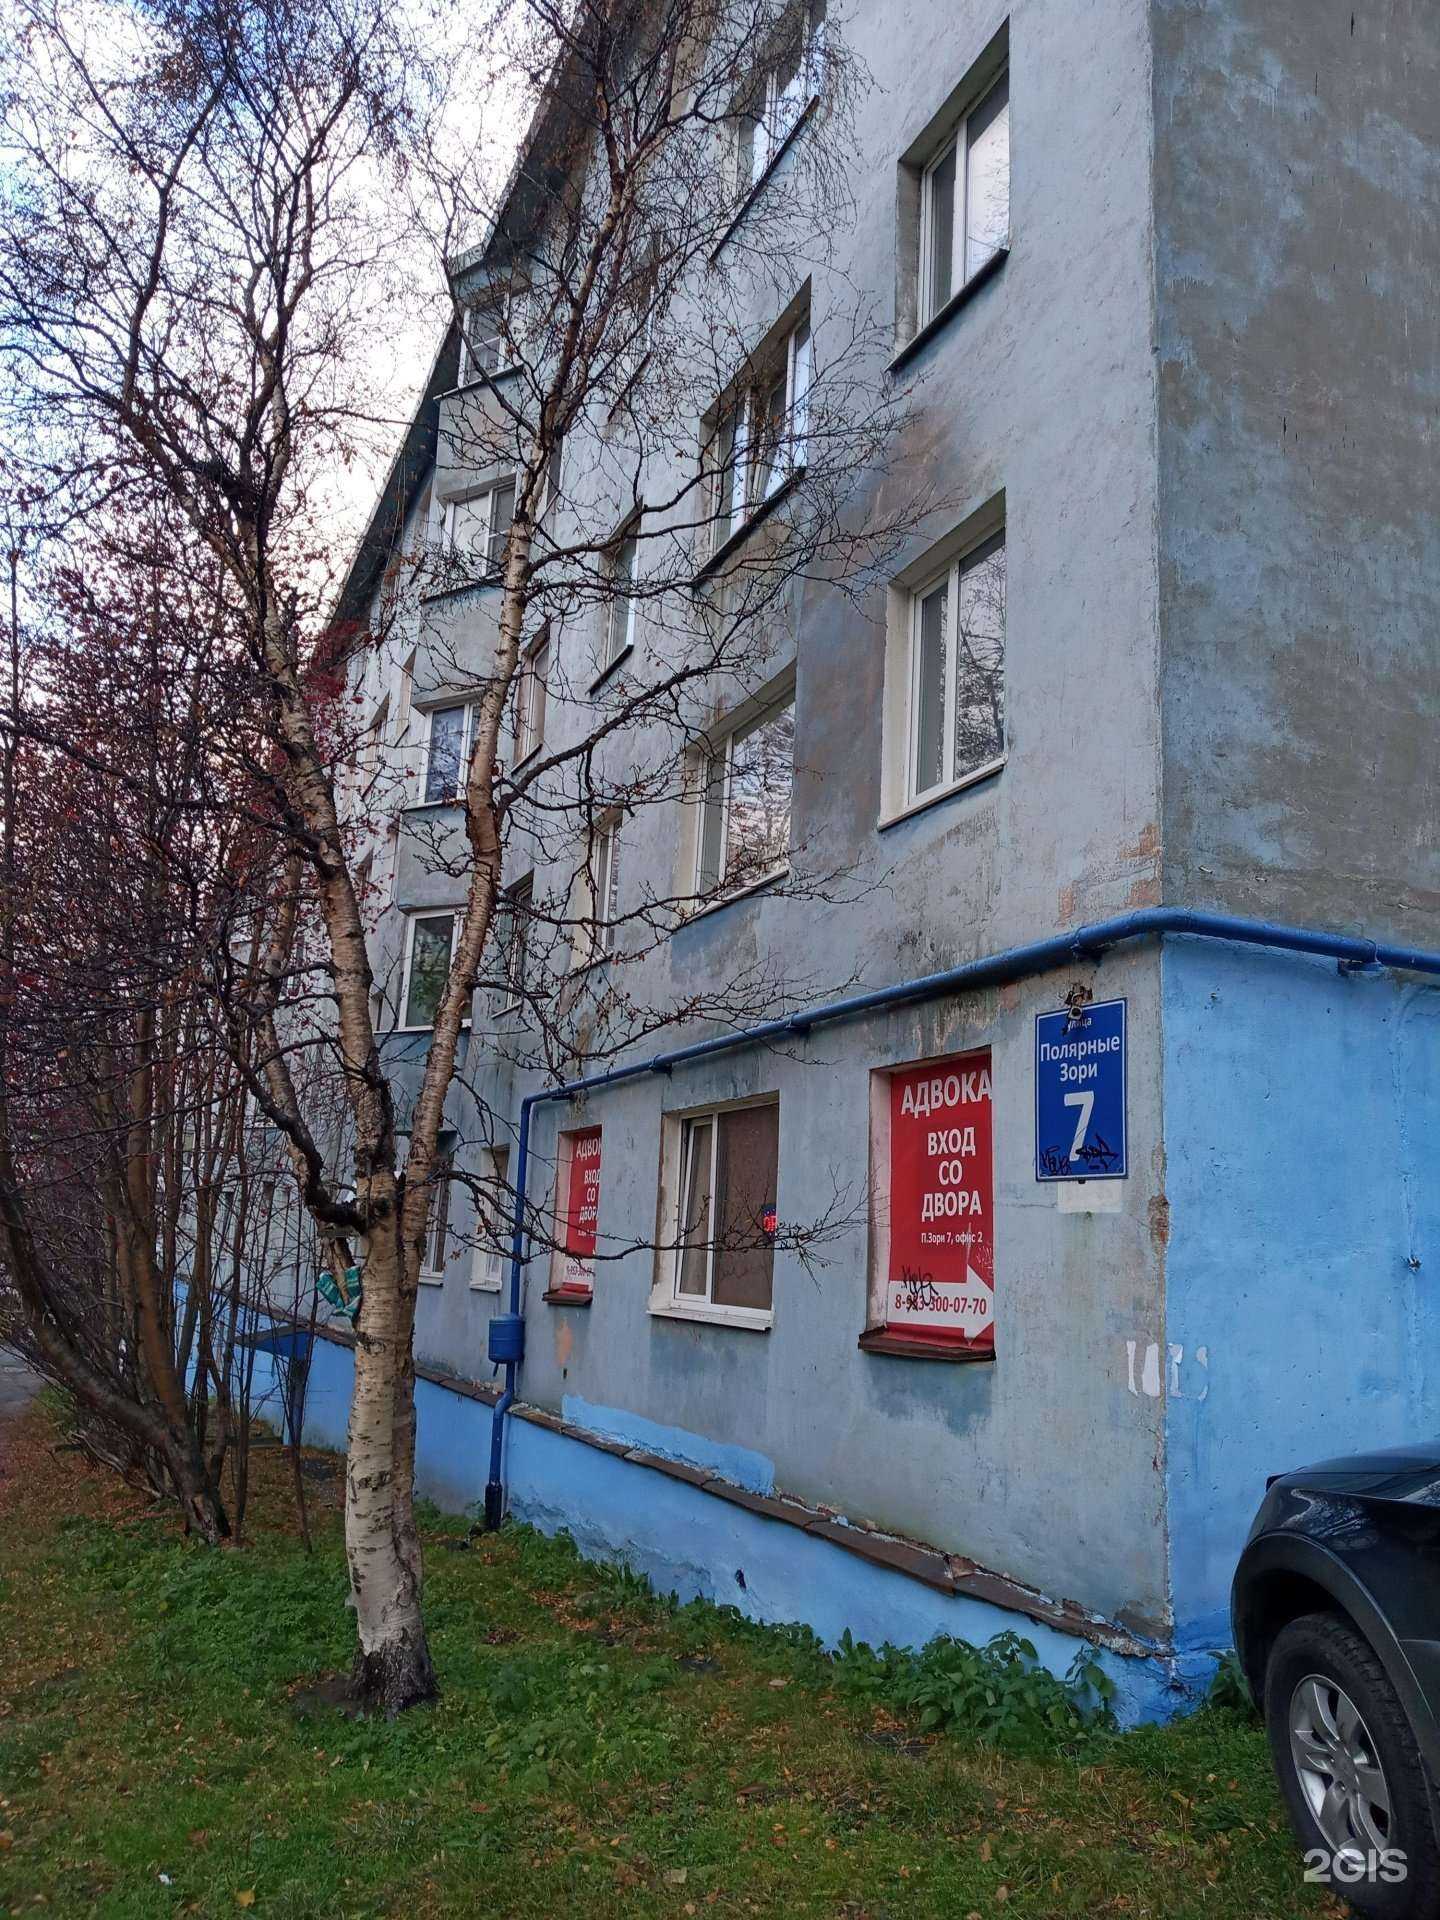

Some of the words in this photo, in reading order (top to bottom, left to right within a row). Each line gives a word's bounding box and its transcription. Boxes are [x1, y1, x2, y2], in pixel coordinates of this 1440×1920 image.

[1041, 1036, 1120, 1061] Полярные
[1060, 1063, 1098, 1084] Зори
[901, 1069, 992, 1119] АДВОКА
[1064, 1090, 1094, 1161] 7
[928, 1127, 976, 1157] ВХОД
[938, 1160, 962, 1185] СО
[587, 1187, 596, 1202] СО
[921, 1190, 982, 1222] ДВОРА
[977, 1231, 983, 1242] 2
